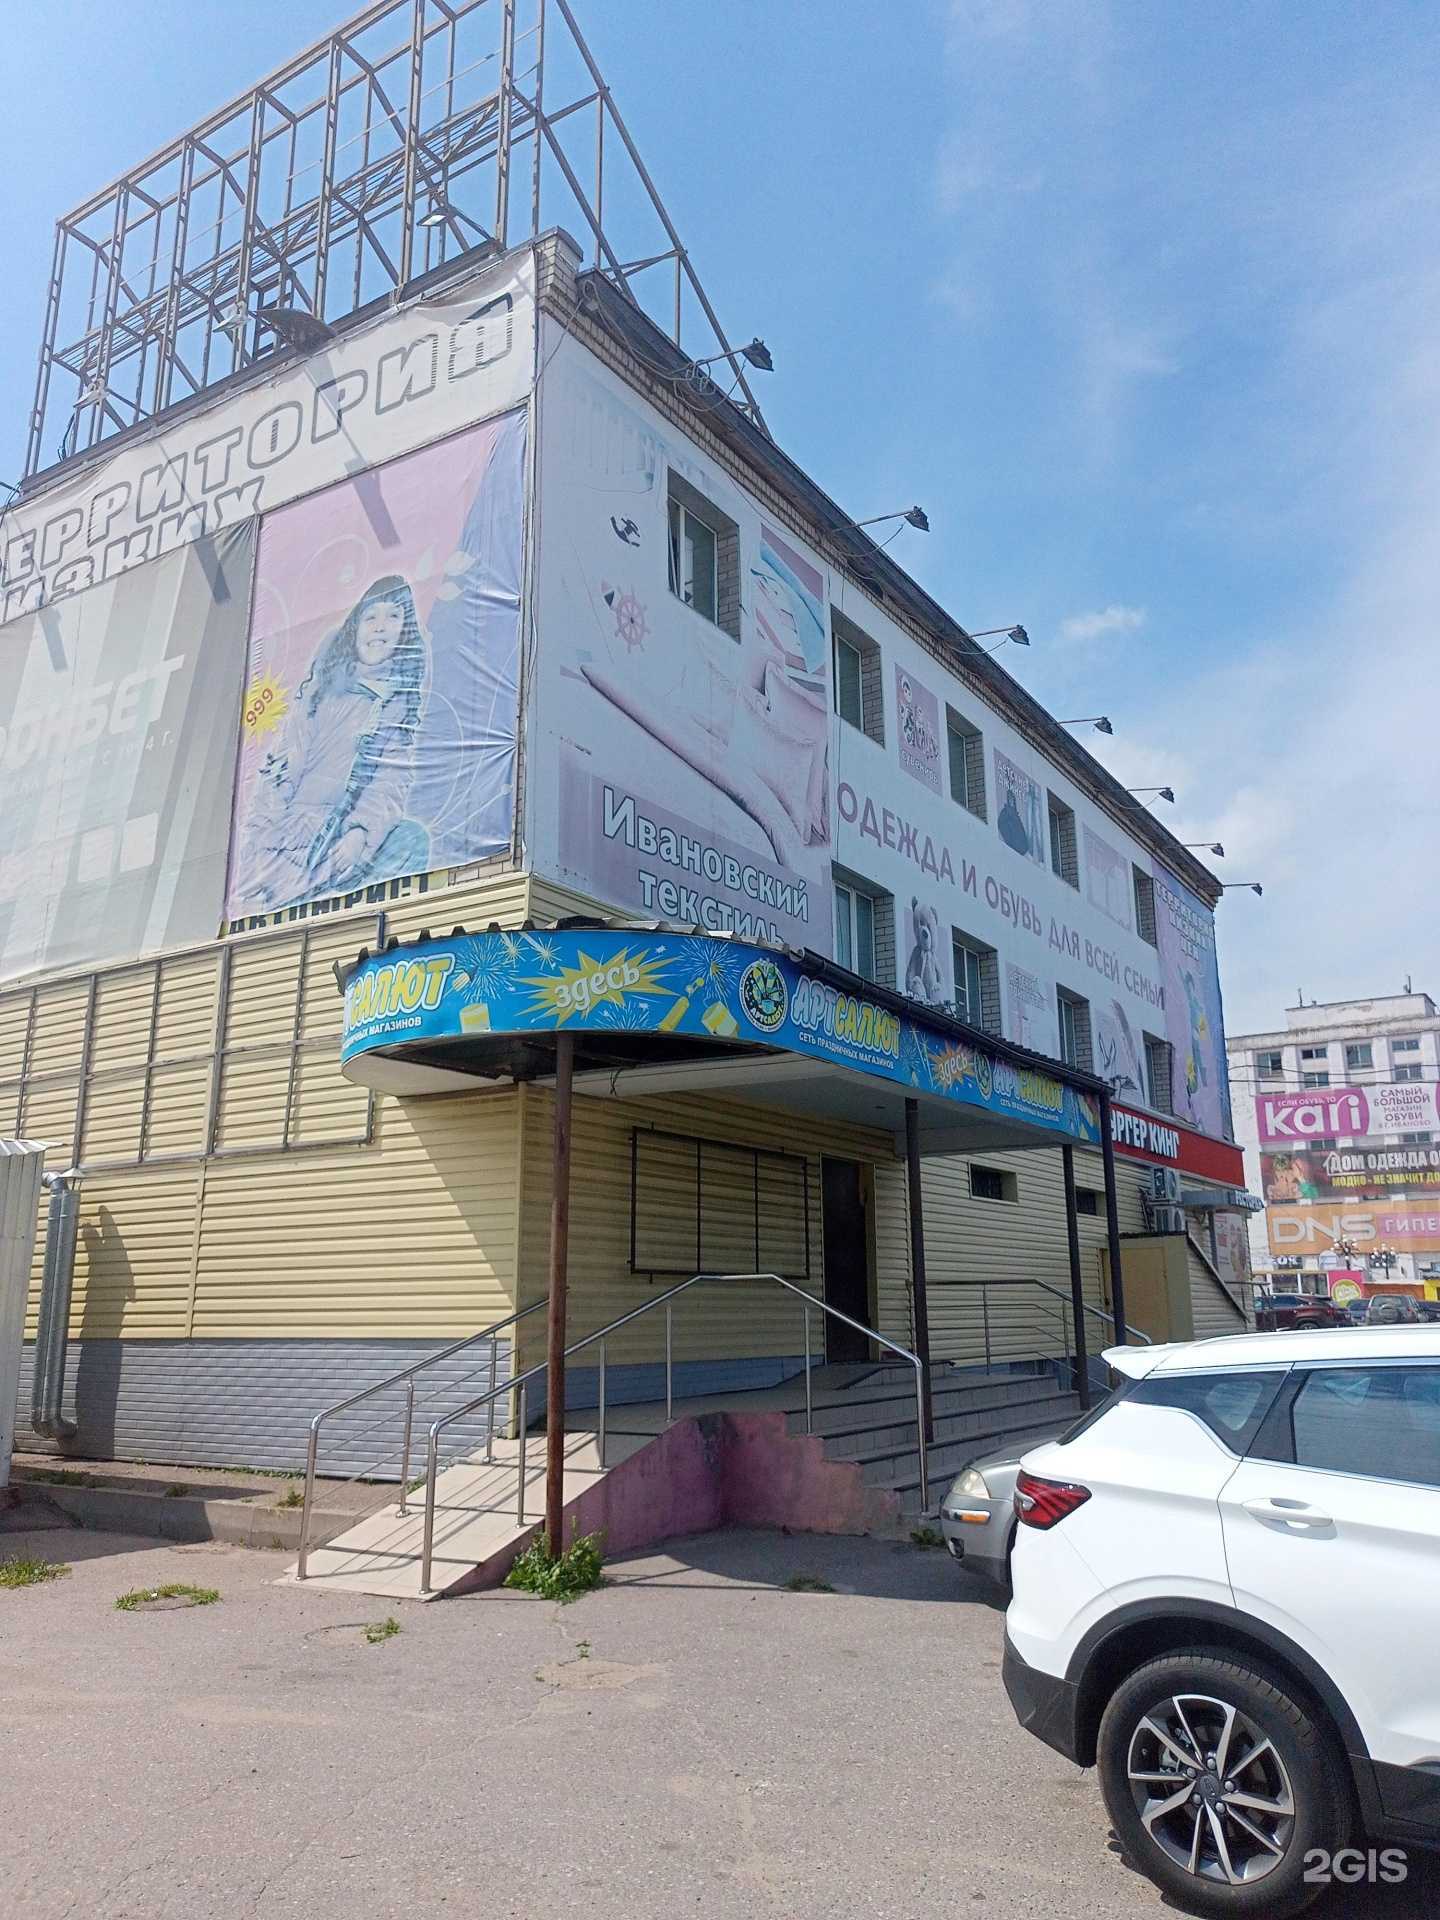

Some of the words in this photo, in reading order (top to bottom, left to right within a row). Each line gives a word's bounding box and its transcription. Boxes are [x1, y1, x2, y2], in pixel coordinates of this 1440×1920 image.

[0, 291, 513, 588] ЕРРИТОРИЯ
[246, 688, 273, 727] 999
[603, 784, 810, 923] Ивановский
[836, 782, 956, 885] ОДЕЖДА
[962, 858, 978, 898] И
[984, 875, 1043, 937] ОБУВЬ
[1049, 917, 1081, 960] ДЛЯ
[1085, 938, 1120, 984] ВСЕЙ
[1124, 965, 1166, 1011] СЕМЬИ
[554, 961, 640, 1011] здесь
[369, 1016, 421, 1035] МАГАЗИНОВ
[791, 975, 900, 1059] АРТСАЛЮТ
[799, 1031, 816, 1045] СЕТЬ
[817, 1038, 858, 1061] ПРАЗДНИЧНЫХ
[858, 1050, 895, 1069] МАГАЗИНОВ
[940, 1054, 968, 1084] здесь
[1374, 1095, 1431, 1107] БОЛЬШОЙ
[1380, 1086, 1423, 1097] САМЫЙ
[1265, 1095, 1361, 1136] kari
[1384, 1105, 1422, 1113] МАГАЗИН
[1384, 1113, 1423, 1122] ОБУВИ
[1148, 1122, 1180, 1160] КИНГ
[1330, 1153, 1365, 1173] ДОМ
[1368, 1152, 1425, 1171] ОДЕЖДА
[1429, 1151, 1440, 1167] О
[1332, 1175, 1367, 1188] МОДНО
[1374, 1174, 1386, 1185] НЕ
[1387, 1173, 1424, 1185] ЗНАЧИТ
[1272, 1215, 1377, 1244] DNS
[1385, 1217, 1440, 1232] ГИПЕ
